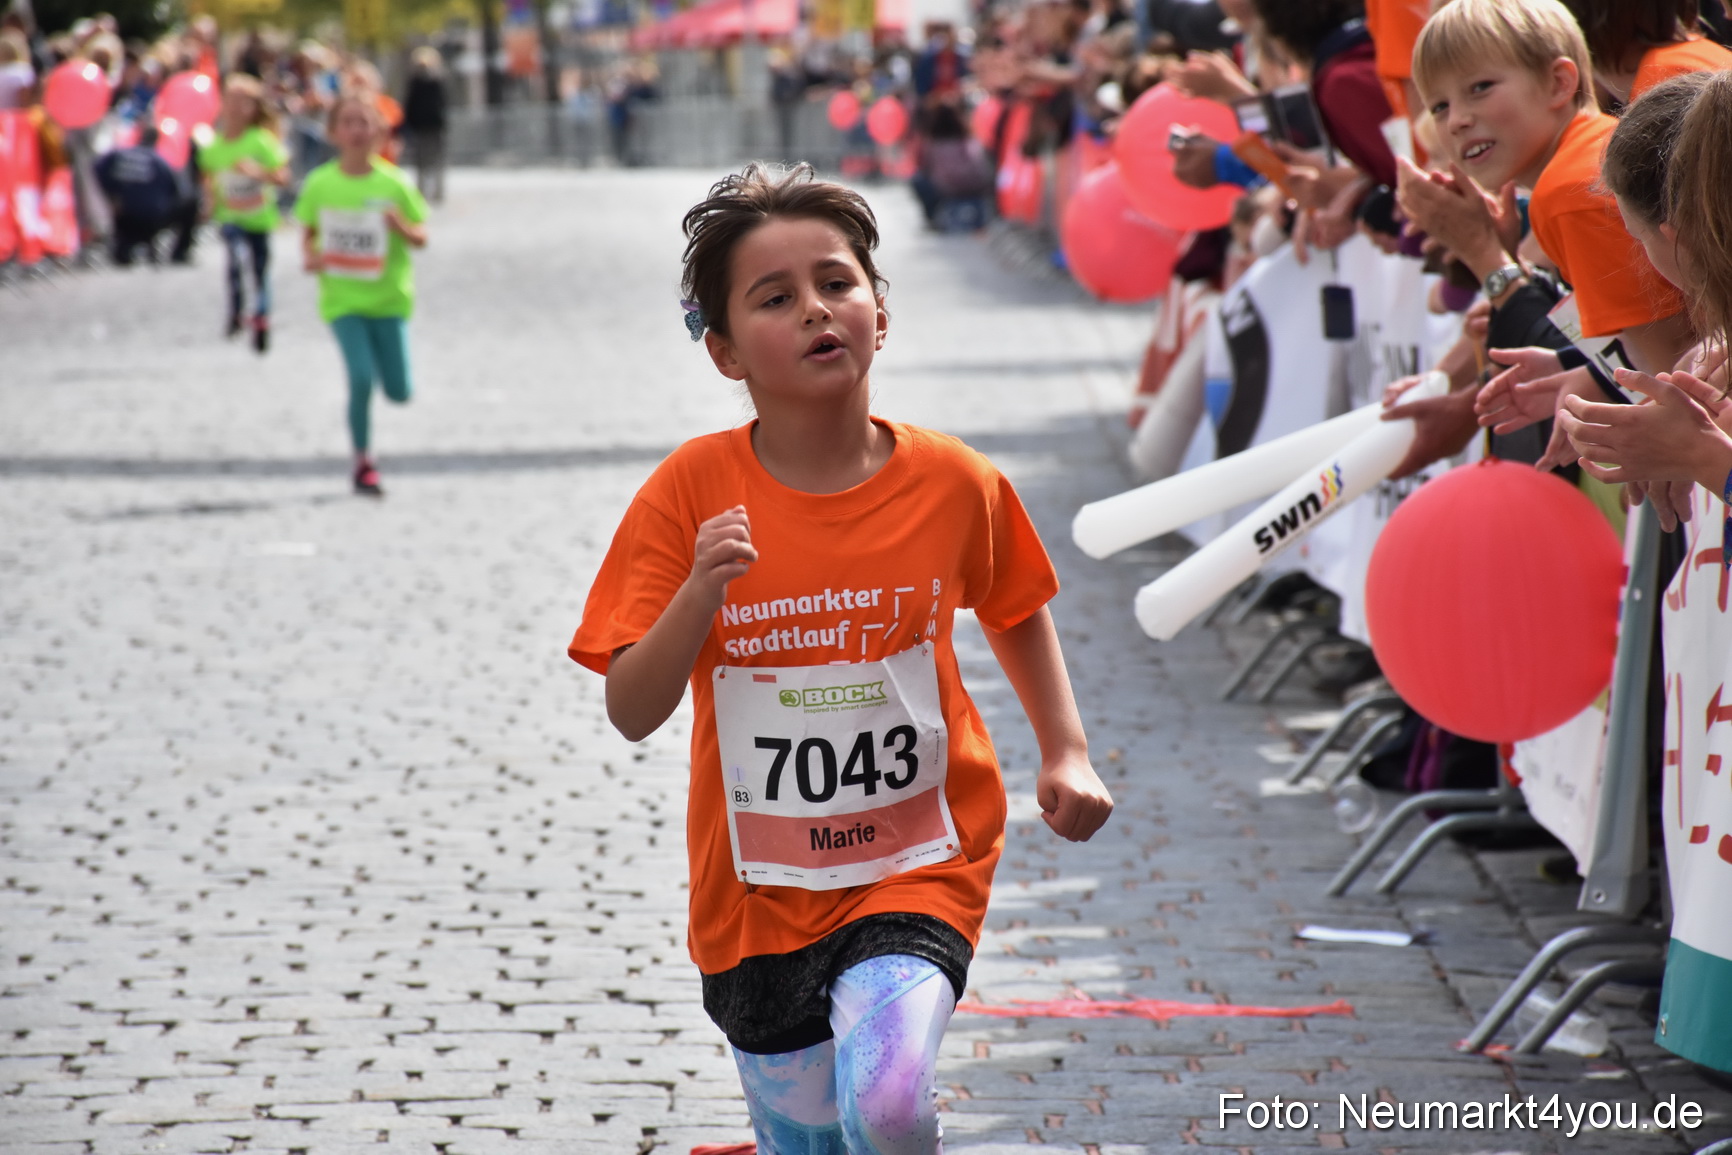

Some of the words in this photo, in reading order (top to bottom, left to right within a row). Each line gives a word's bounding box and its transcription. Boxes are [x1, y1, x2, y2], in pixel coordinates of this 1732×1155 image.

[1254, 492, 1322, 554] swn
[721, 588, 883, 627] Neumarkter
[725, 620, 851, 659] Stadtlauf
[803, 681, 887, 707] BOCK
[803, 706, 830, 715] inspired
[860, 699, 889, 709] concepts
[754, 724, 919, 803] 7043
[734, 790, 750, 804] B3
[809, 822, 876, 851] Marie
